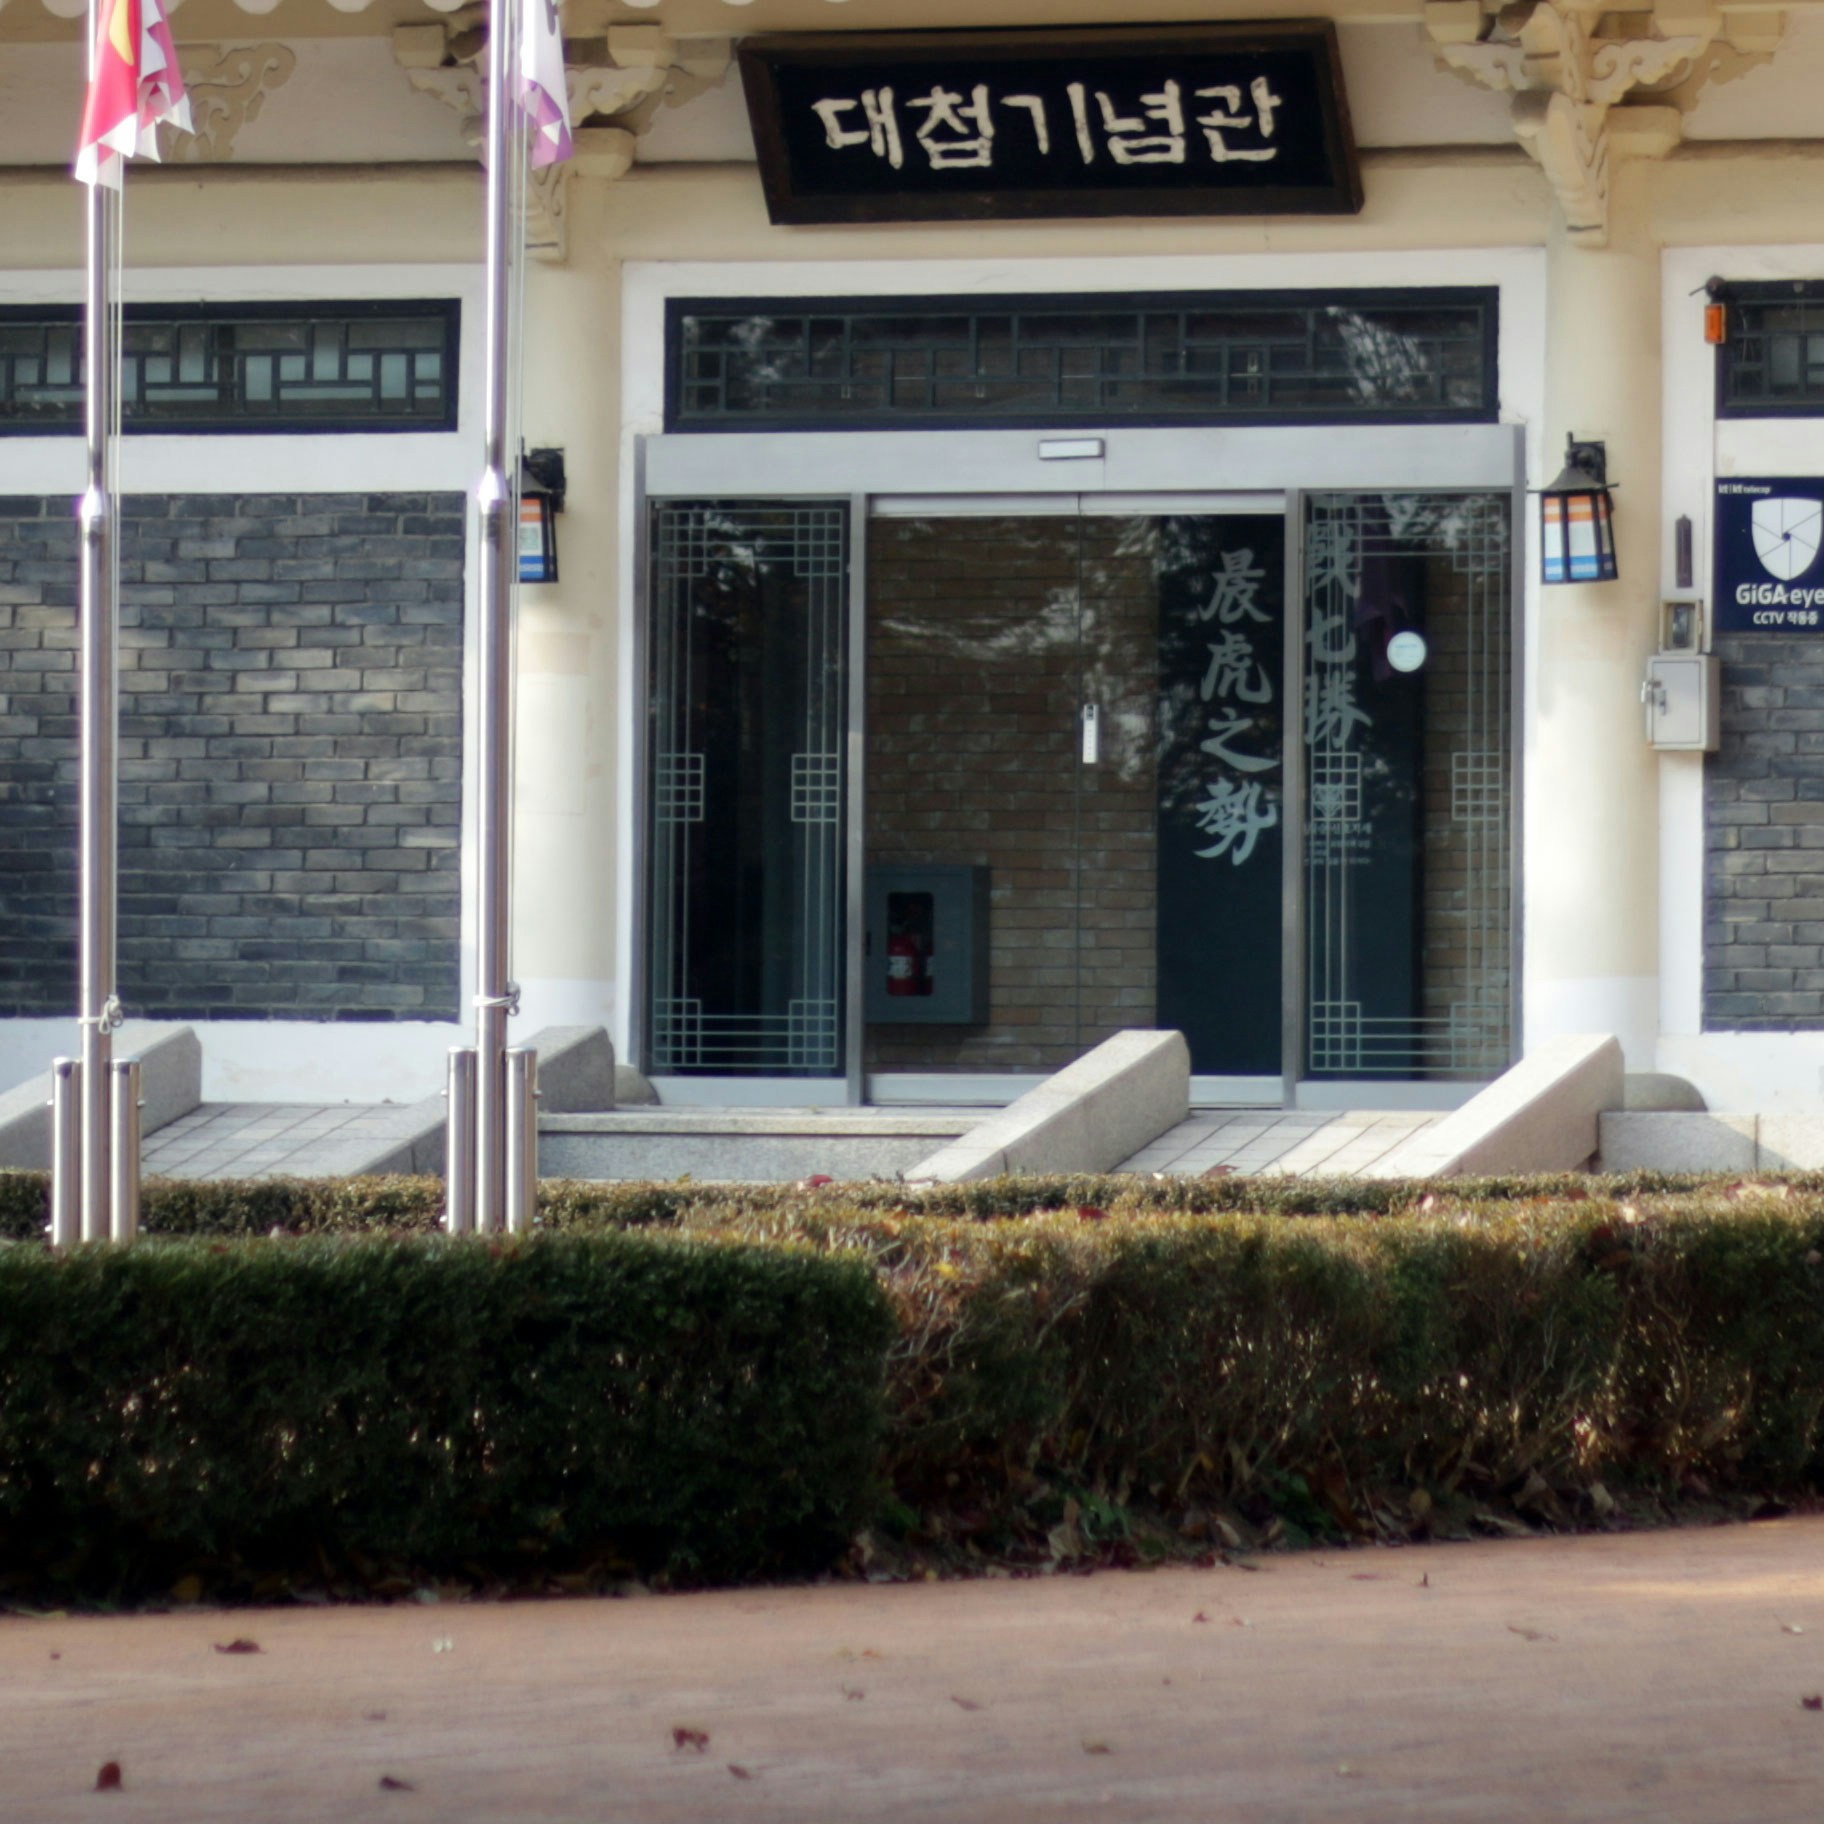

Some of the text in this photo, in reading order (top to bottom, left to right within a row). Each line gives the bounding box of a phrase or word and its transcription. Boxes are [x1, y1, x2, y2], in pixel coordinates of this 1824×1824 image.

[811, 75, 1282, 170] 대첩기념관
[1753, 612, 1784, 624] CCTV
[1193, 547, 1280, 866] 晨虎之勢
